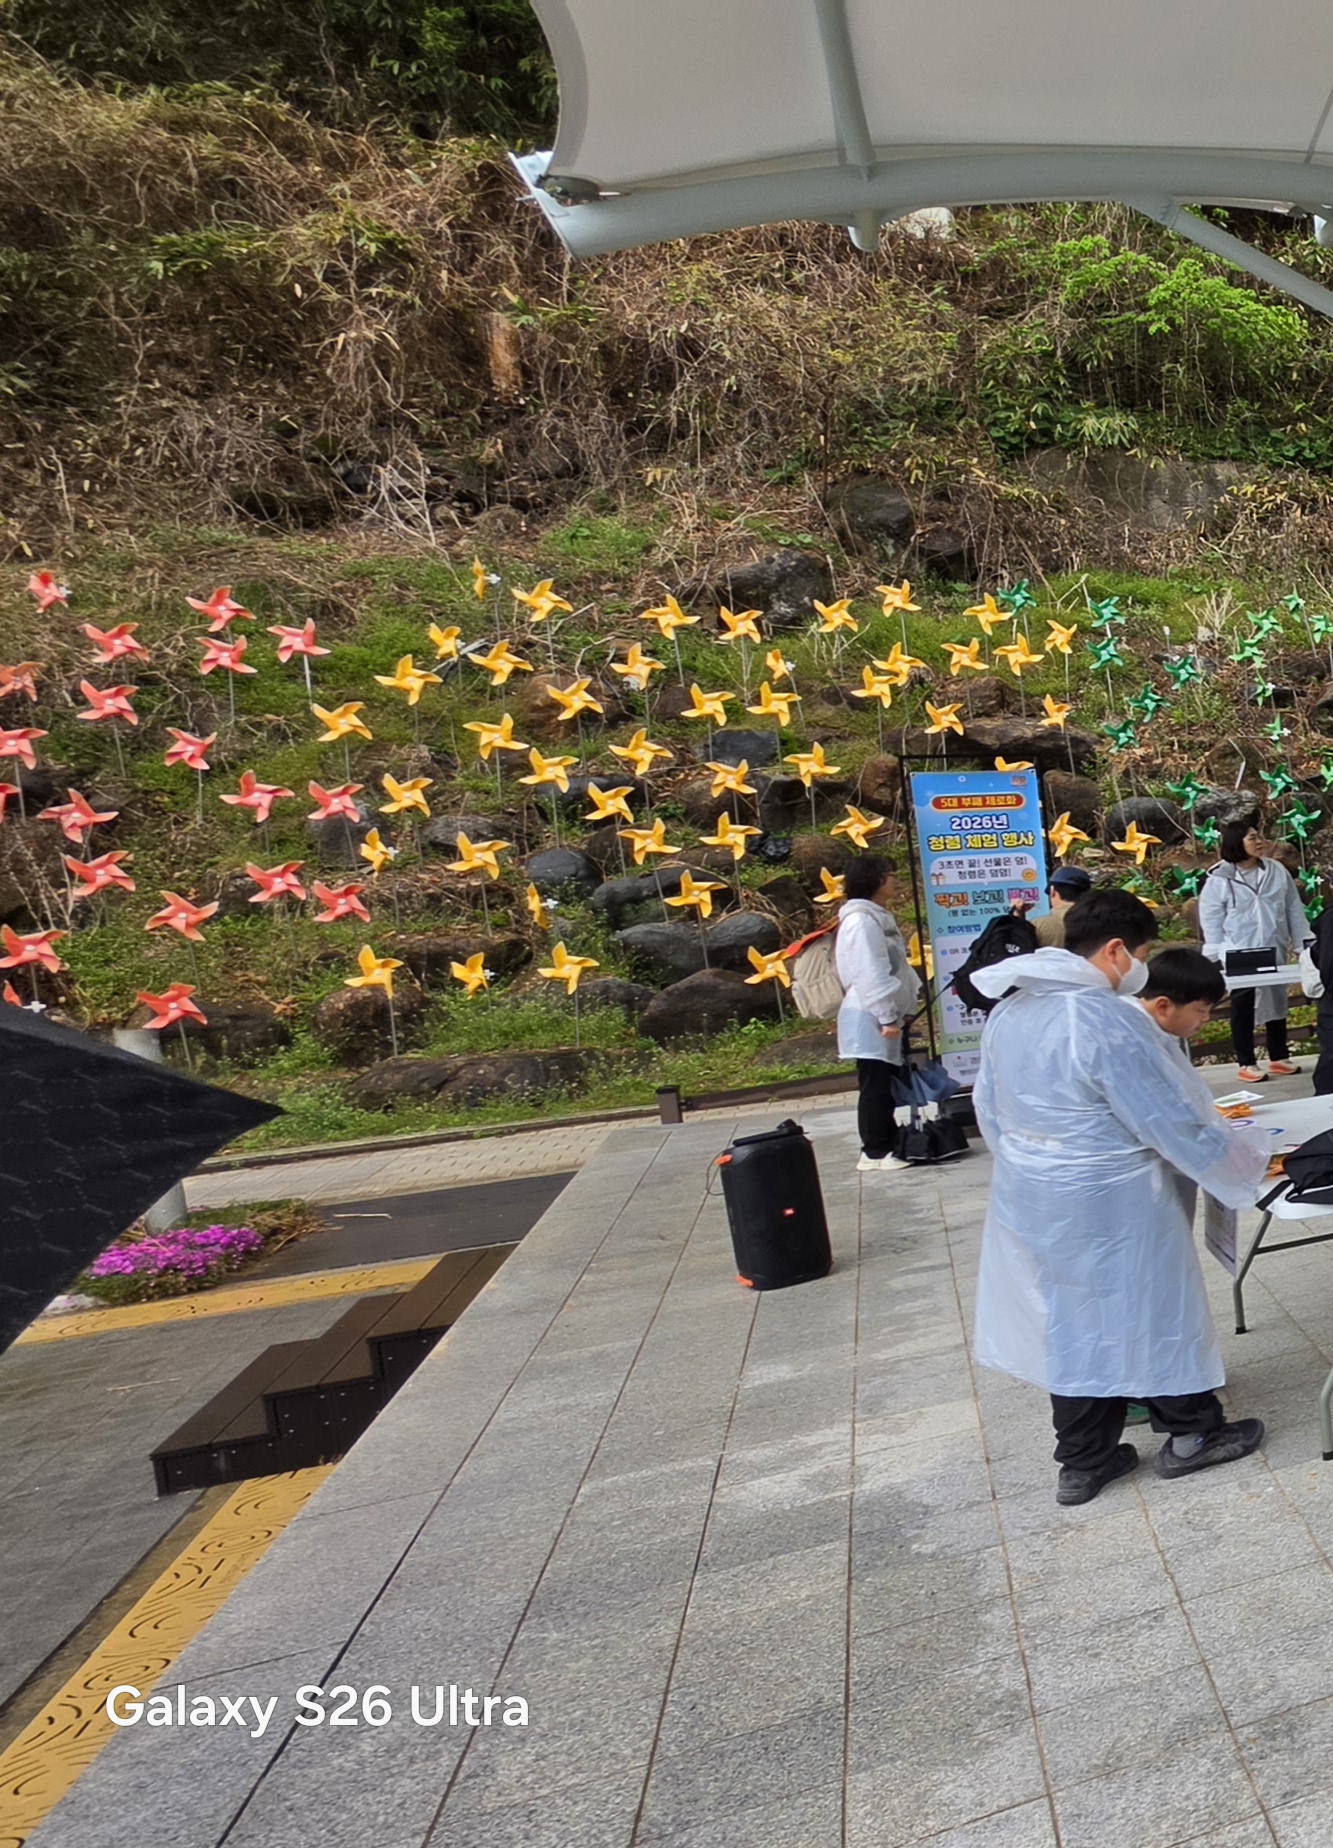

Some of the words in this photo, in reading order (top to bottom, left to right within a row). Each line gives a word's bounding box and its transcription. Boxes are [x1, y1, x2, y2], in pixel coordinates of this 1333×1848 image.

[940, 798, 958, 808] 5대
[962, 796, 982, 806] 부패
[985, 795, 1017, 806] 제로화
[951, 813, 1009, 830] 2026년
[928, 835, 961, 851] 청렴
[965, 833, 998, 849] 체험
[1001, 831, 1034, 848] 행사
[938, 860, 964, 870] 3초면
[983, 857, 1011, 867] 선물은
[958, 869, 986, 880] 청렴은
[972, 889, 1004, 904] 보고!
[980, 907, 1000, 915] 100%
